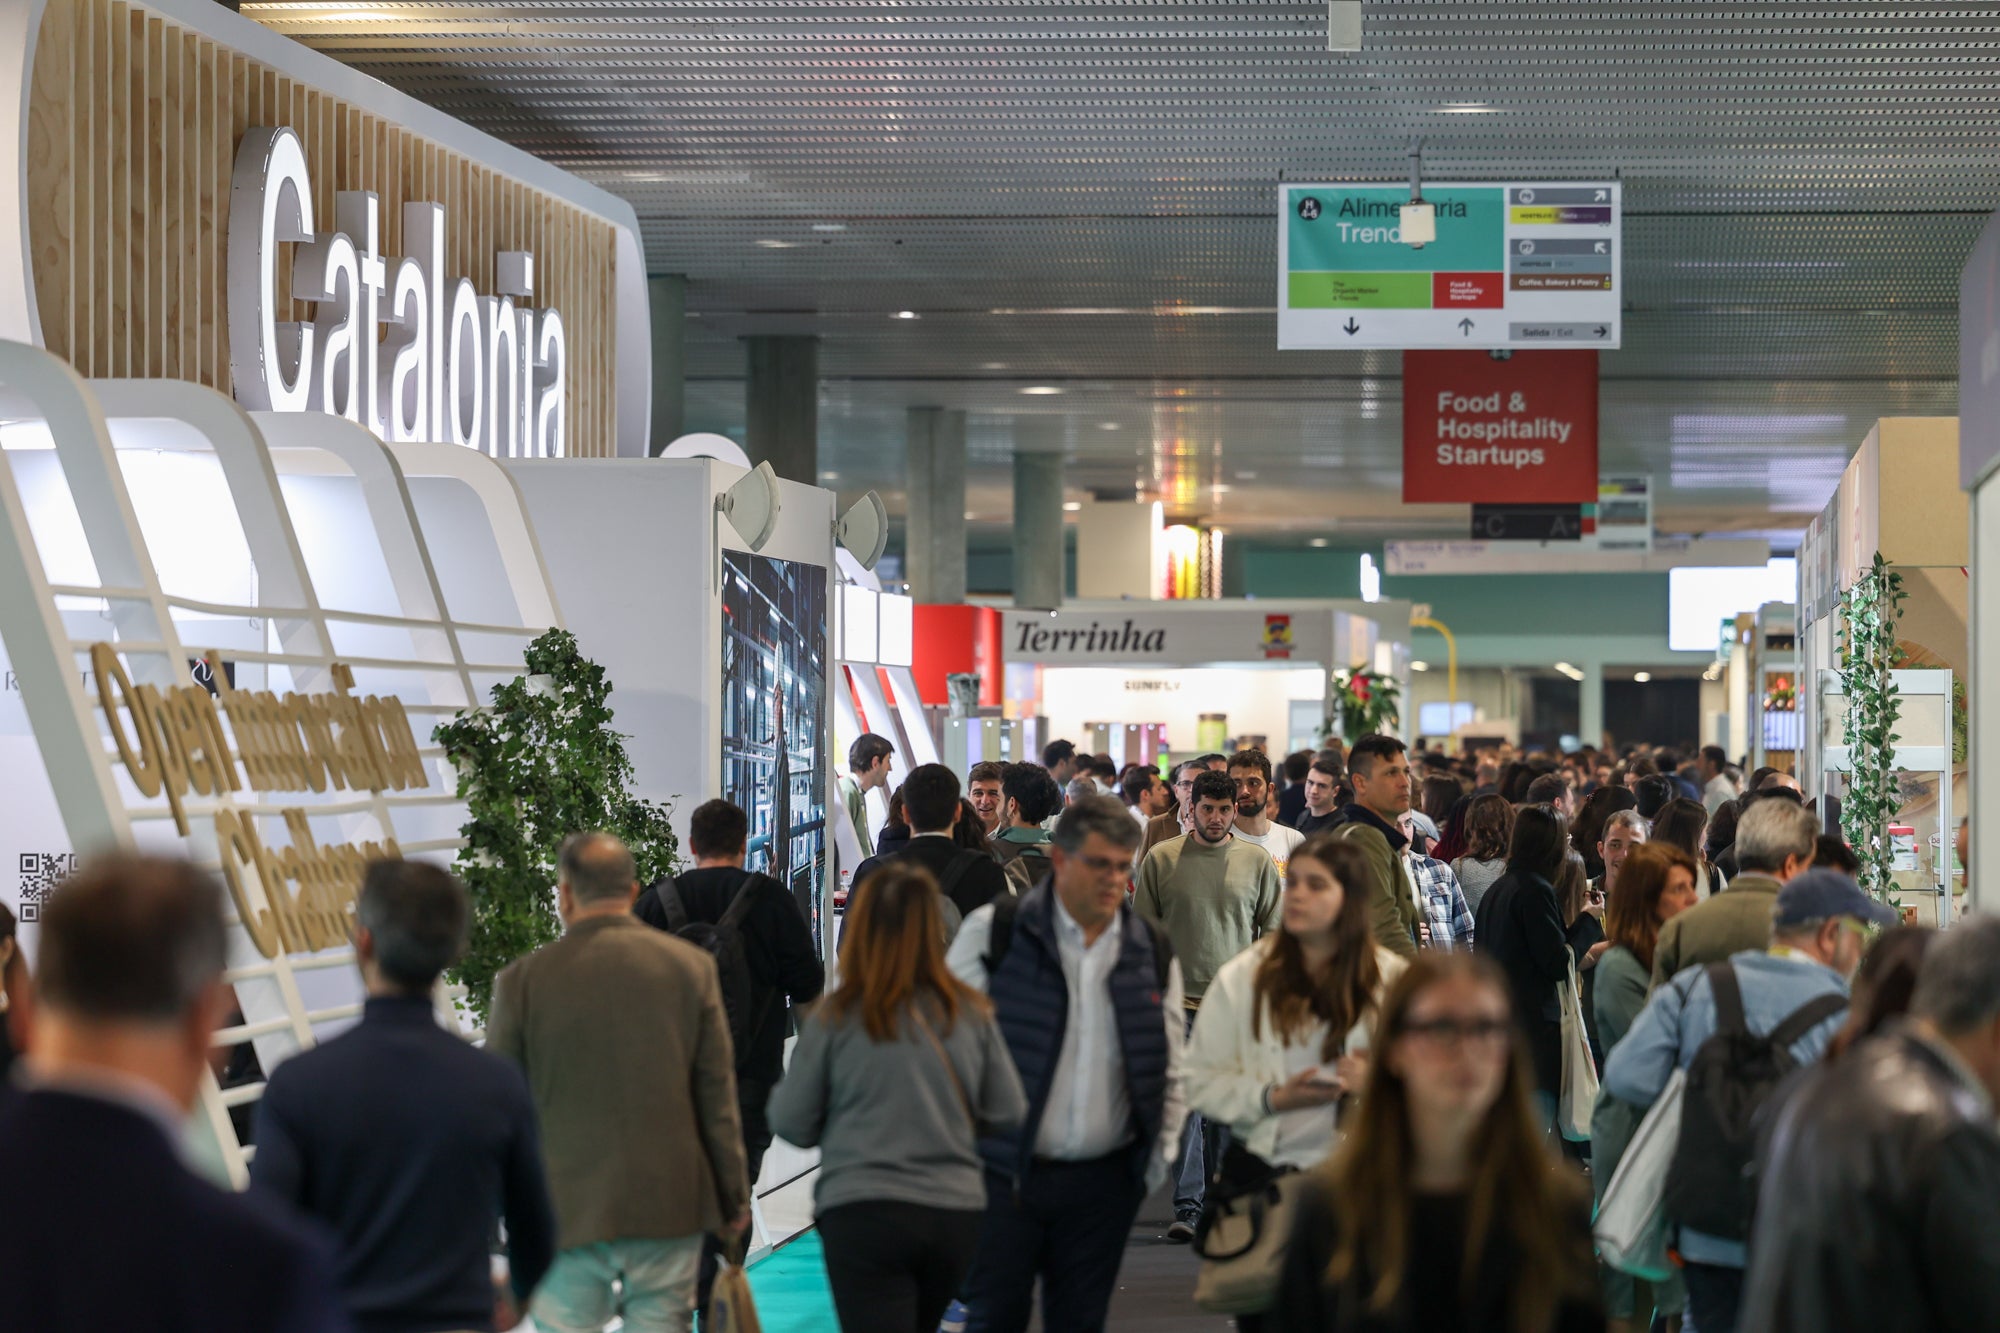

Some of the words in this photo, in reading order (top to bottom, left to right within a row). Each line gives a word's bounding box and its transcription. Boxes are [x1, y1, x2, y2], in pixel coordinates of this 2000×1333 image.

[1301, 209, 1318, 219] 4-6
[1304, 200, 1314, 208] H
[1339, 198, 1467, 218] Alimeria
[1336, 222, 1402, 244] Trend
[229, 126, 566, 458] Catalonia
[1450, 288, 1483, 296] Hospitality
[1519, 278, 1544, 287] Coffee,
[1545, 278, 1569, 288] Bakery
[1577, 278, 1600, 288] Pastry
[1450, 294, 1477, 302] Startups
[1522, 328, 1550, 337] Salida
[1557, 328, 1574, 337] Exit
[1437, 391, 1500, 413] Food
[1508, 391, 1526, 413] &
[1437, 417, 1572, 444] Hospitality
[1437, 444, 1545, 470] Startups
[1550, 516, 1568, 537] A
[1016, 619, 1166, 652] Terrinha
[91, 641, 243, 837] Open
